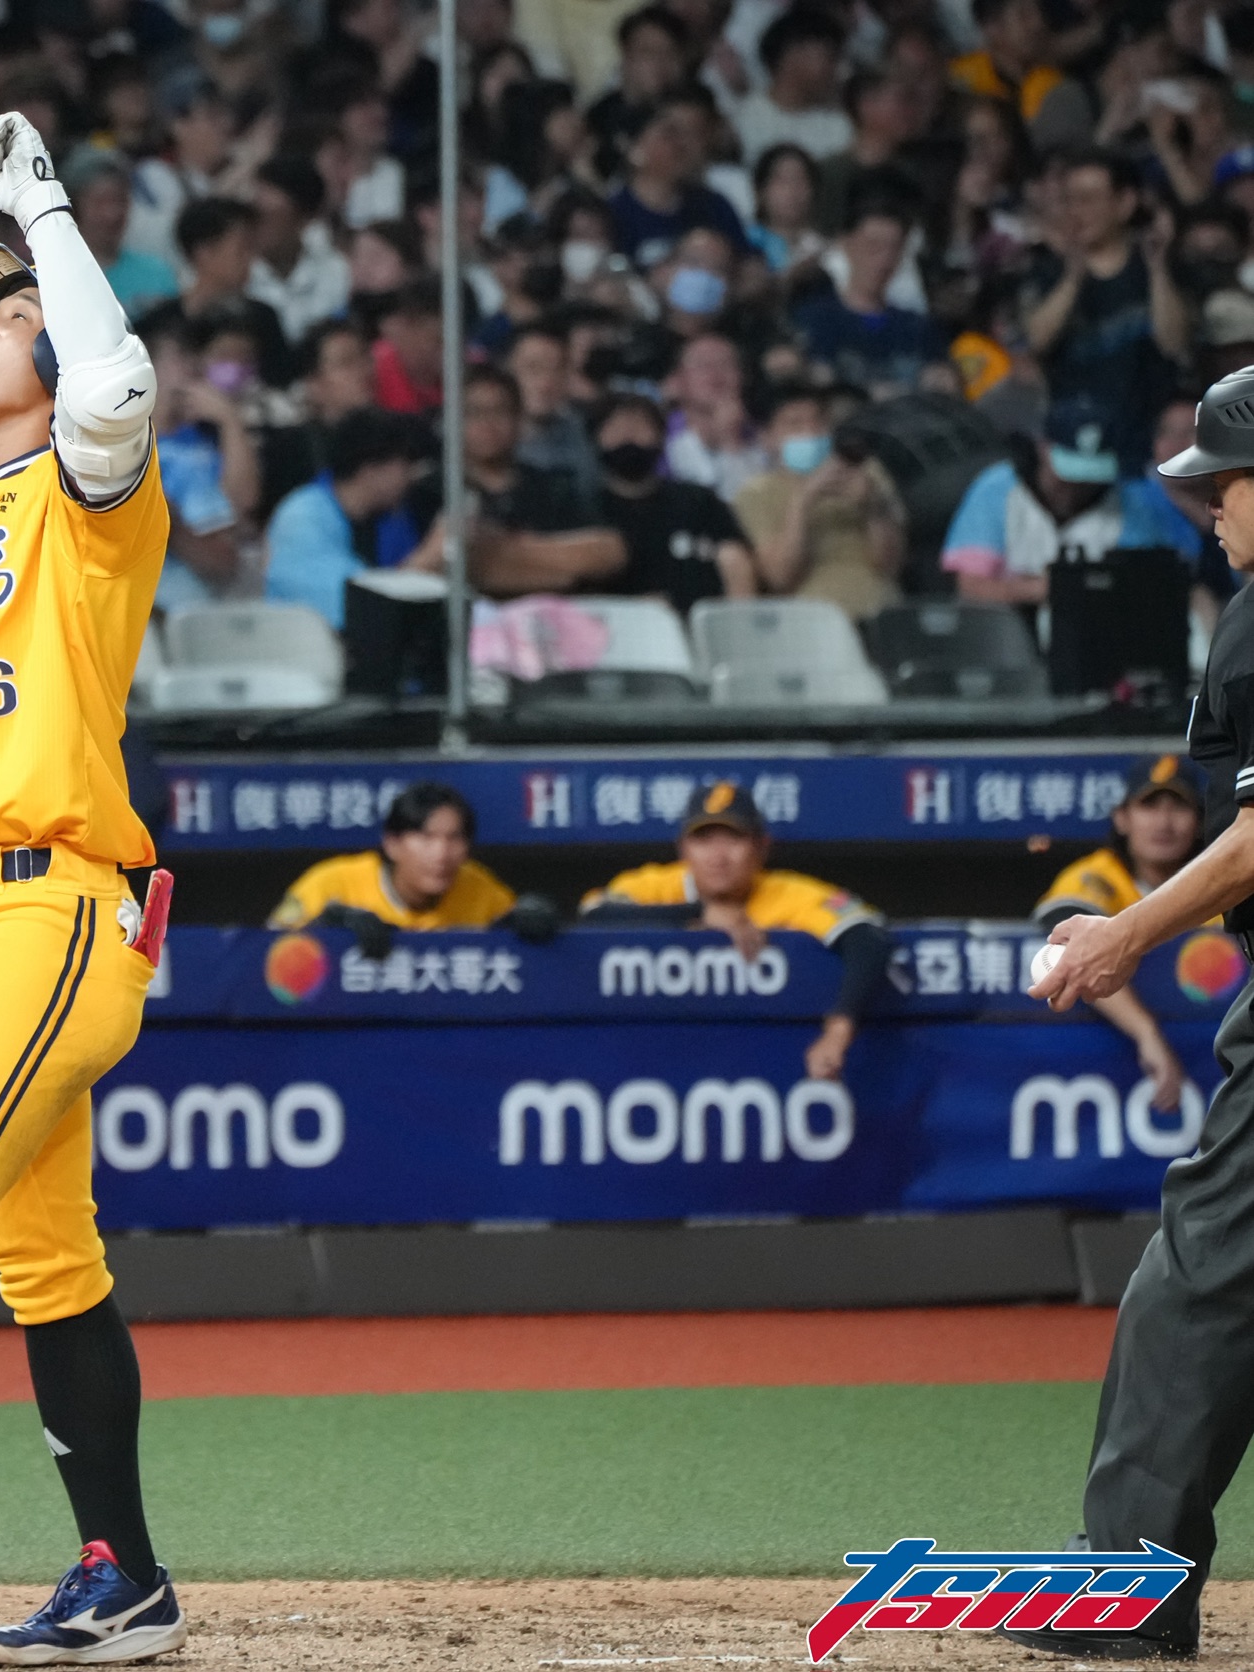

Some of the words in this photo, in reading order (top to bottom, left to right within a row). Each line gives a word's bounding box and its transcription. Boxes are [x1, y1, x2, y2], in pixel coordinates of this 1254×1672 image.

[595, 772, 800, 826] 復華信
[975, 769, 1128, 823] 復華投
[600, 945, 789, 997] momo
[92, 1079, 346, 1172] omo
[498, 1075, 855, 1166] momo
[1008, 1073, 1226, 1160] mo
